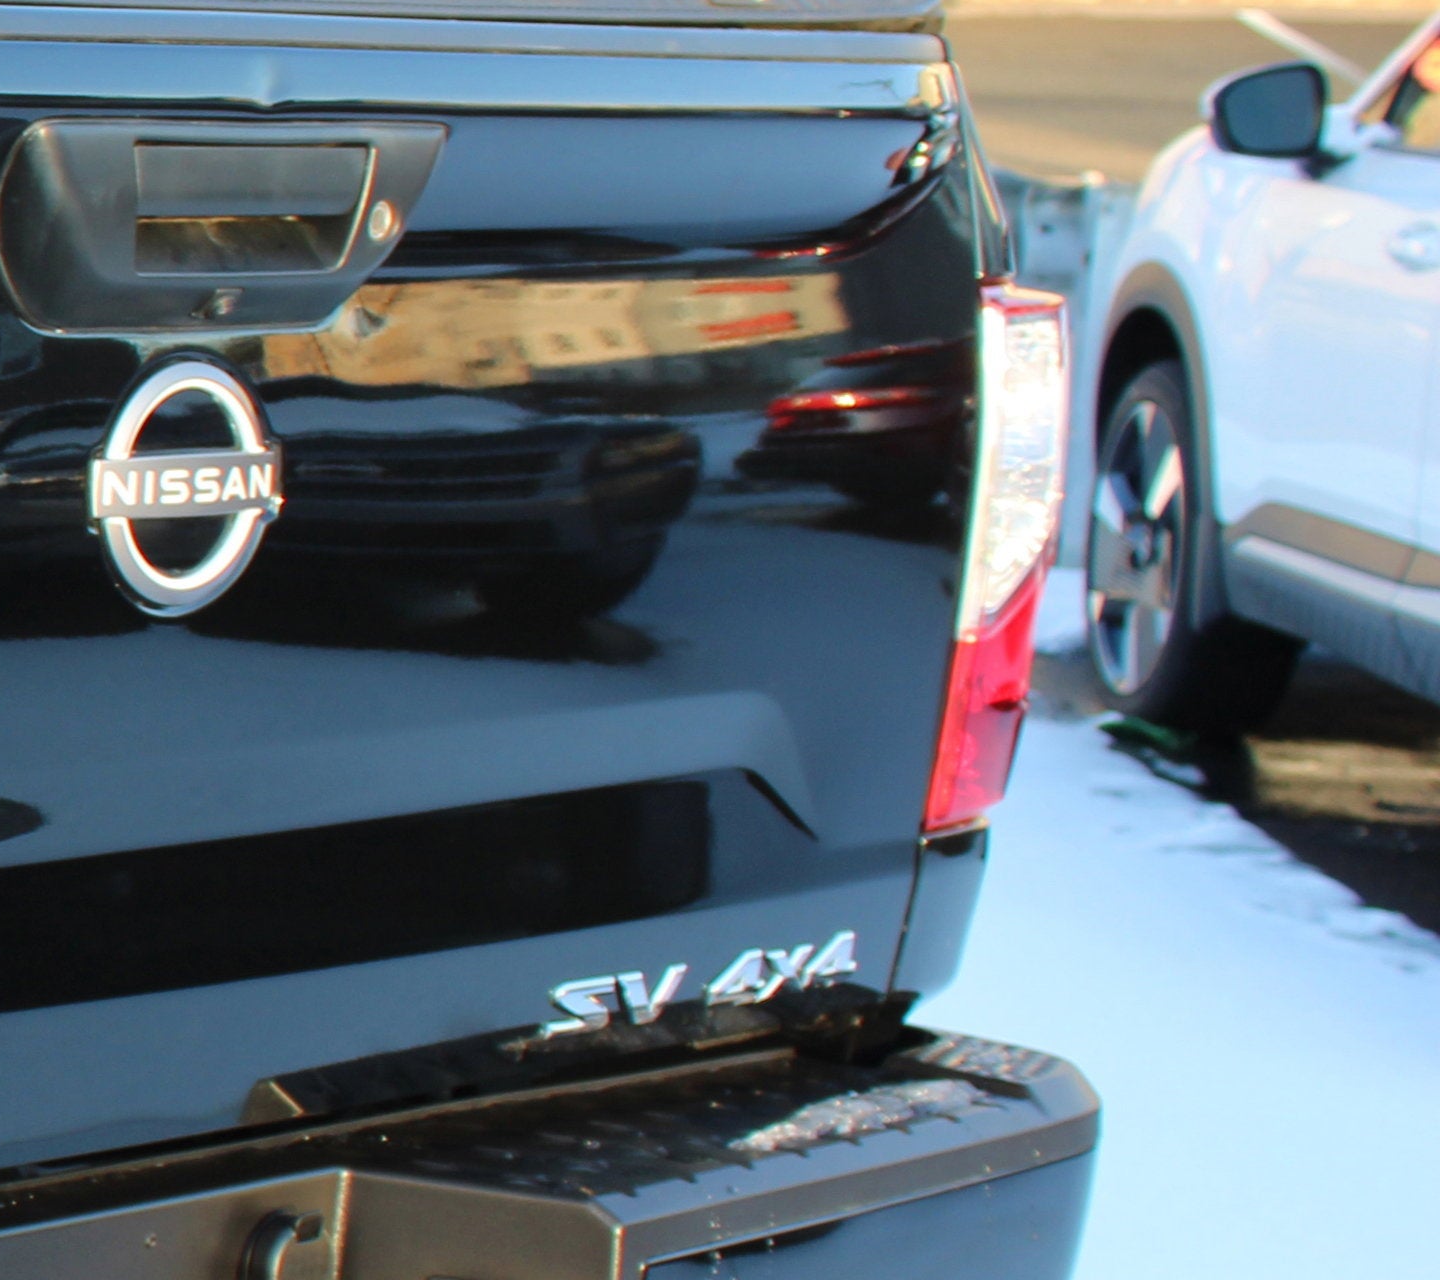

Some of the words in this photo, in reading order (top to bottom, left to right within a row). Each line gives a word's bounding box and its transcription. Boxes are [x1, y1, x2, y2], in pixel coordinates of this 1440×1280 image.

[101, 463, 275, 507] NISSAN
[539, 962, 689, 1040] SV
[703, 929, 858, 1007] 4X4
